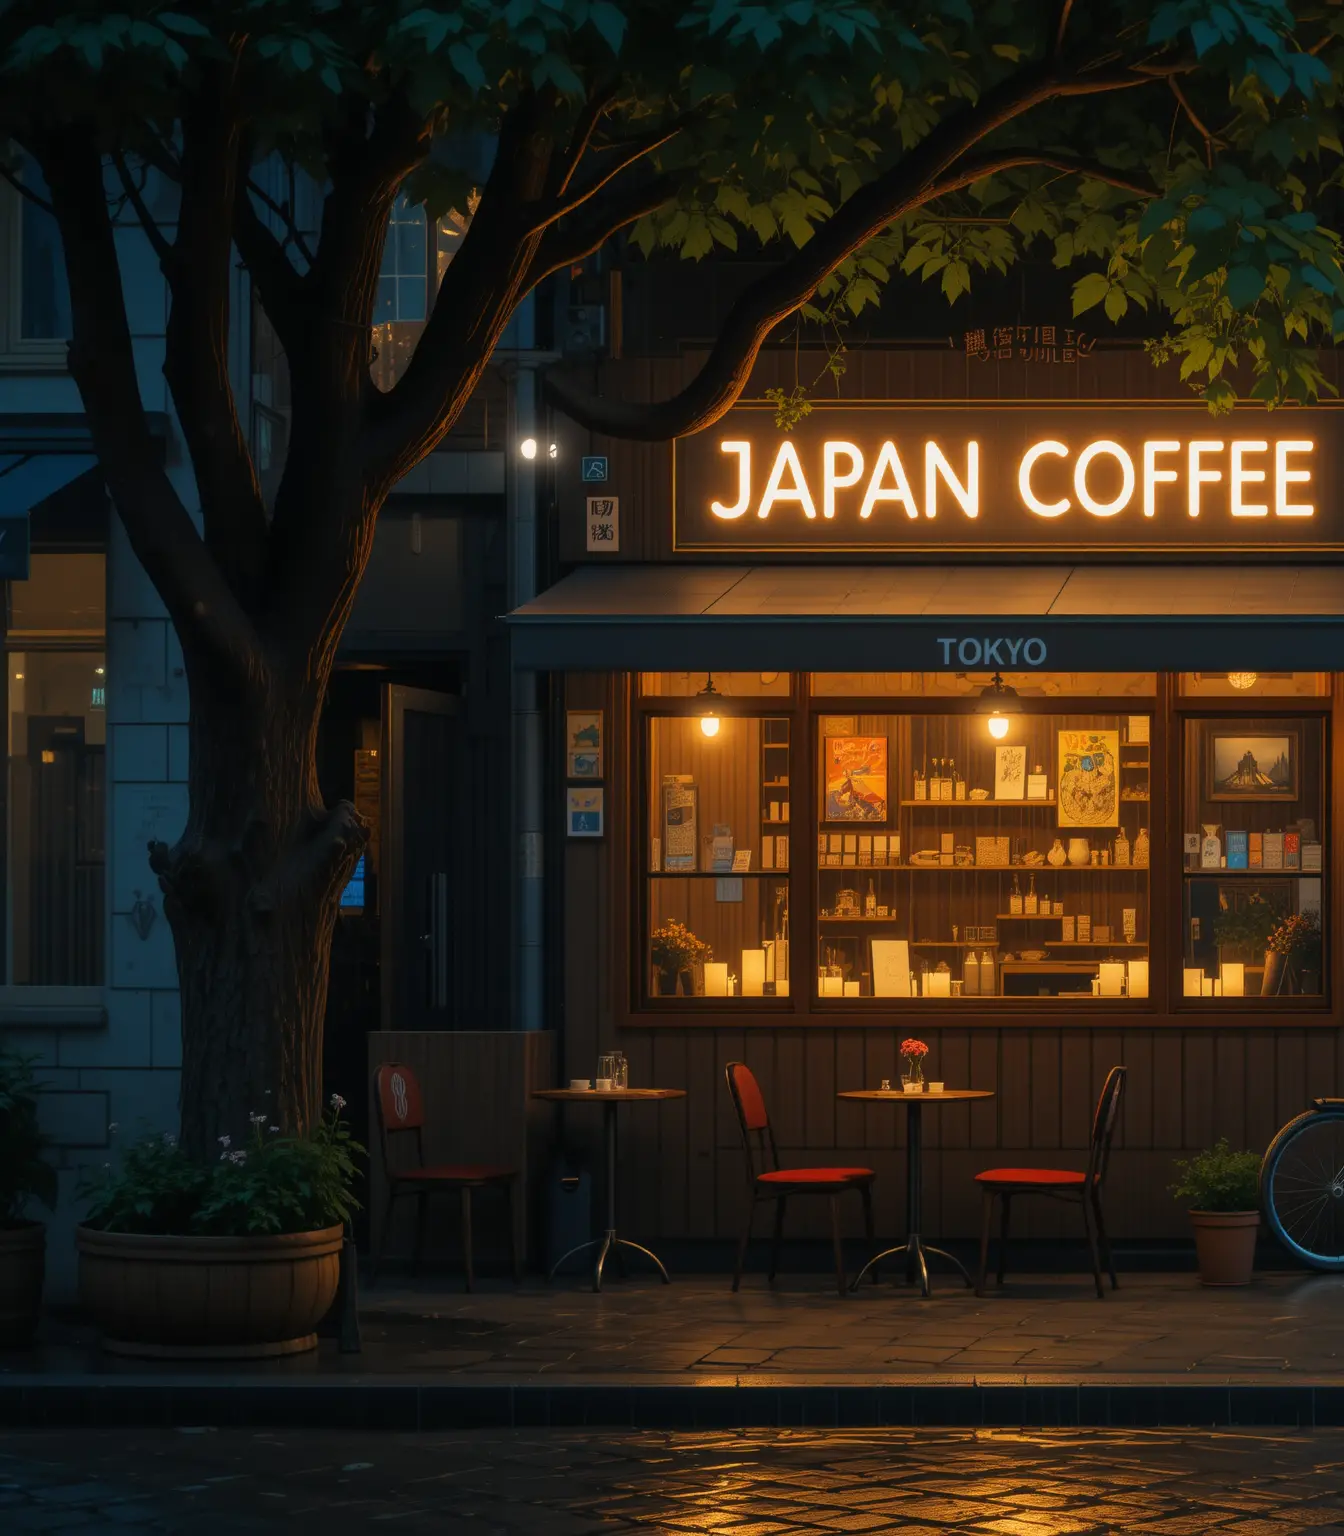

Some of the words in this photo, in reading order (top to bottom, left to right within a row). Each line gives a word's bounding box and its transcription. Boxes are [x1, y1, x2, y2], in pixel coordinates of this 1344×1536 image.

[710, 440, 980, 520] JAPAN
[1017, 439, 1315, 518] COFFEE
[937, 637, 1047, 666] TOKYO
